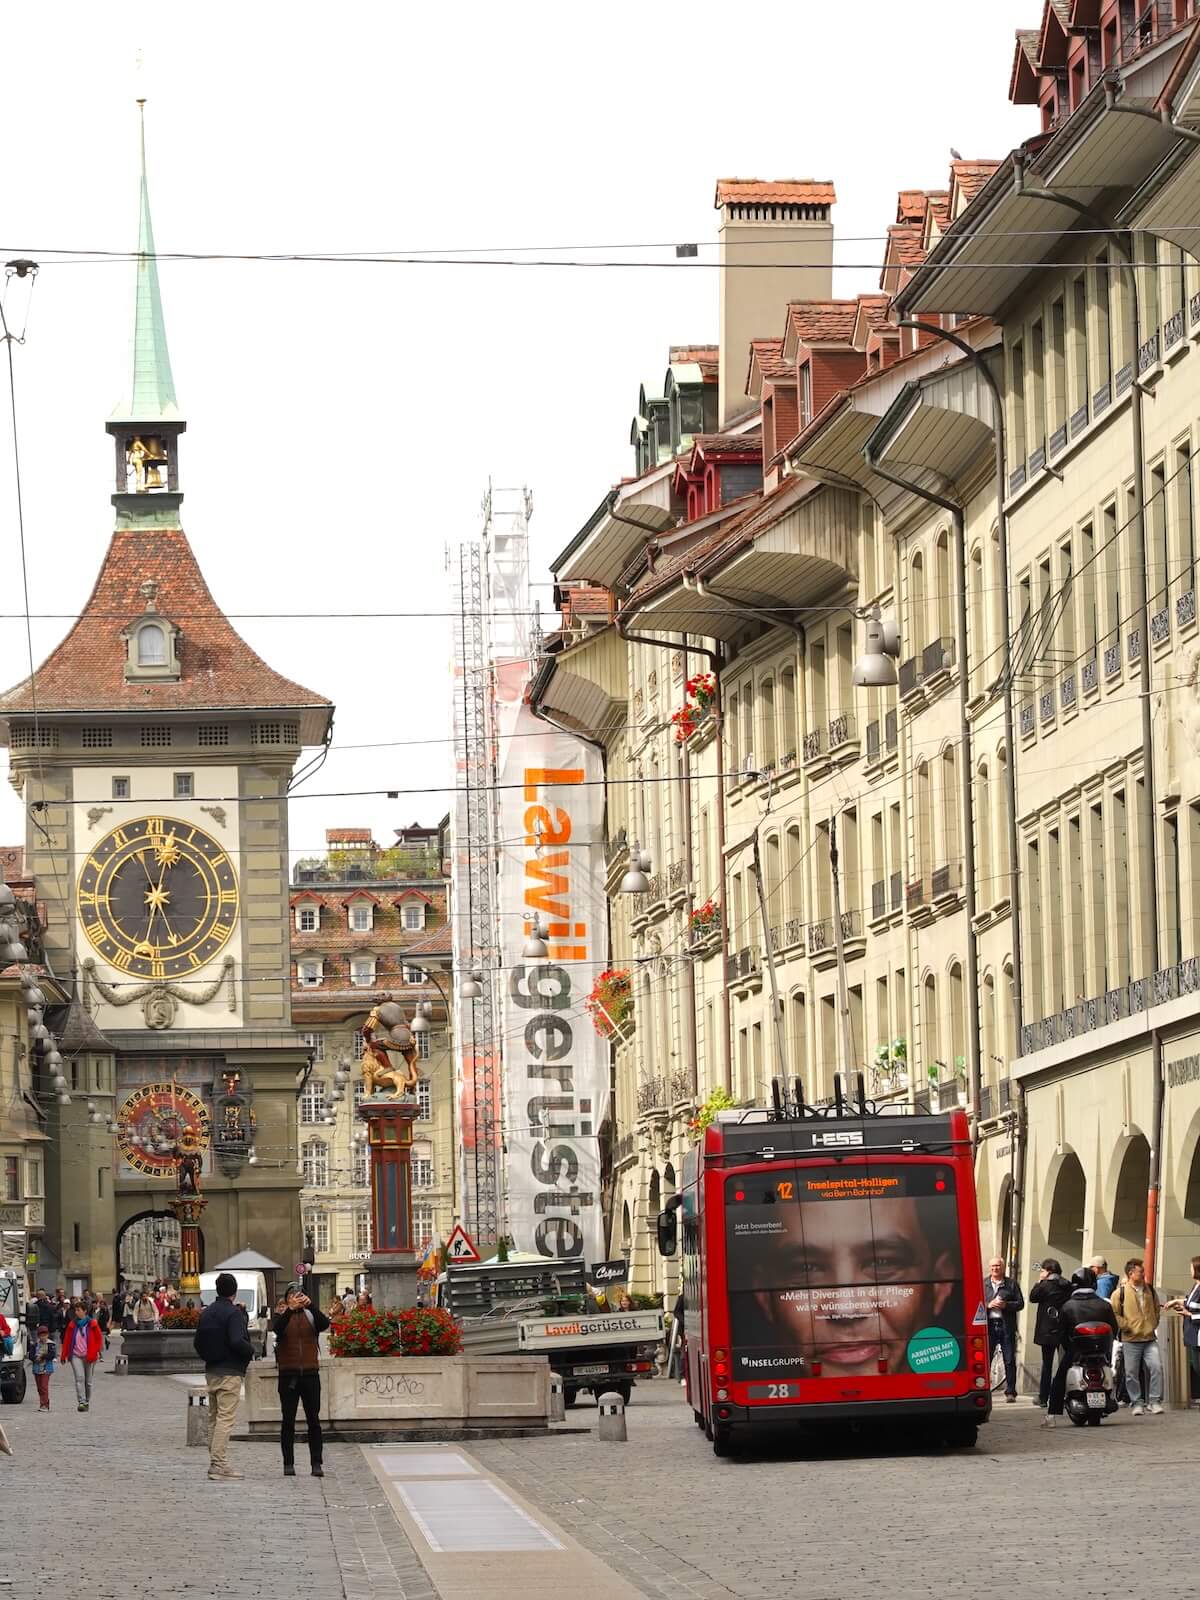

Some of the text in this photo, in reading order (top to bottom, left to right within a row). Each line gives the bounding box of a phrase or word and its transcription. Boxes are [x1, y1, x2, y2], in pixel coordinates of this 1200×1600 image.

[146, 819, 164, 834] XII
[112, 829, 128, 848] XI
[222, 890, 237, 903] III
[812, 1131, 863, 1146] HESS
[777, 1177, 898, 1199] 12 Inselspital-Holligen
[833, 1188, 853, 1198] Bern
[853, 1186, 885, 1196] Bahnhof
[349, 1252, 370, 1260] BUCH
[812, 1289, 855, 1300] Diversität
[857, 1288, 866, 1297] in
[867, 1287, 884, 1297] der
[885, 1286, 914, 1298] Pflege
[795, 1302, 818, 1312] wäre
[544, 1319, 641, 1336] Lawilgerüstet.
[911, 1341, 953, 1359] ARBEITEN MIT
[915, 1349, 953, 1366] DEN BESTEN
[749, 1357, 805, 1367] INSELGRUPPE
[767, 1383, 789, 1399] 28
